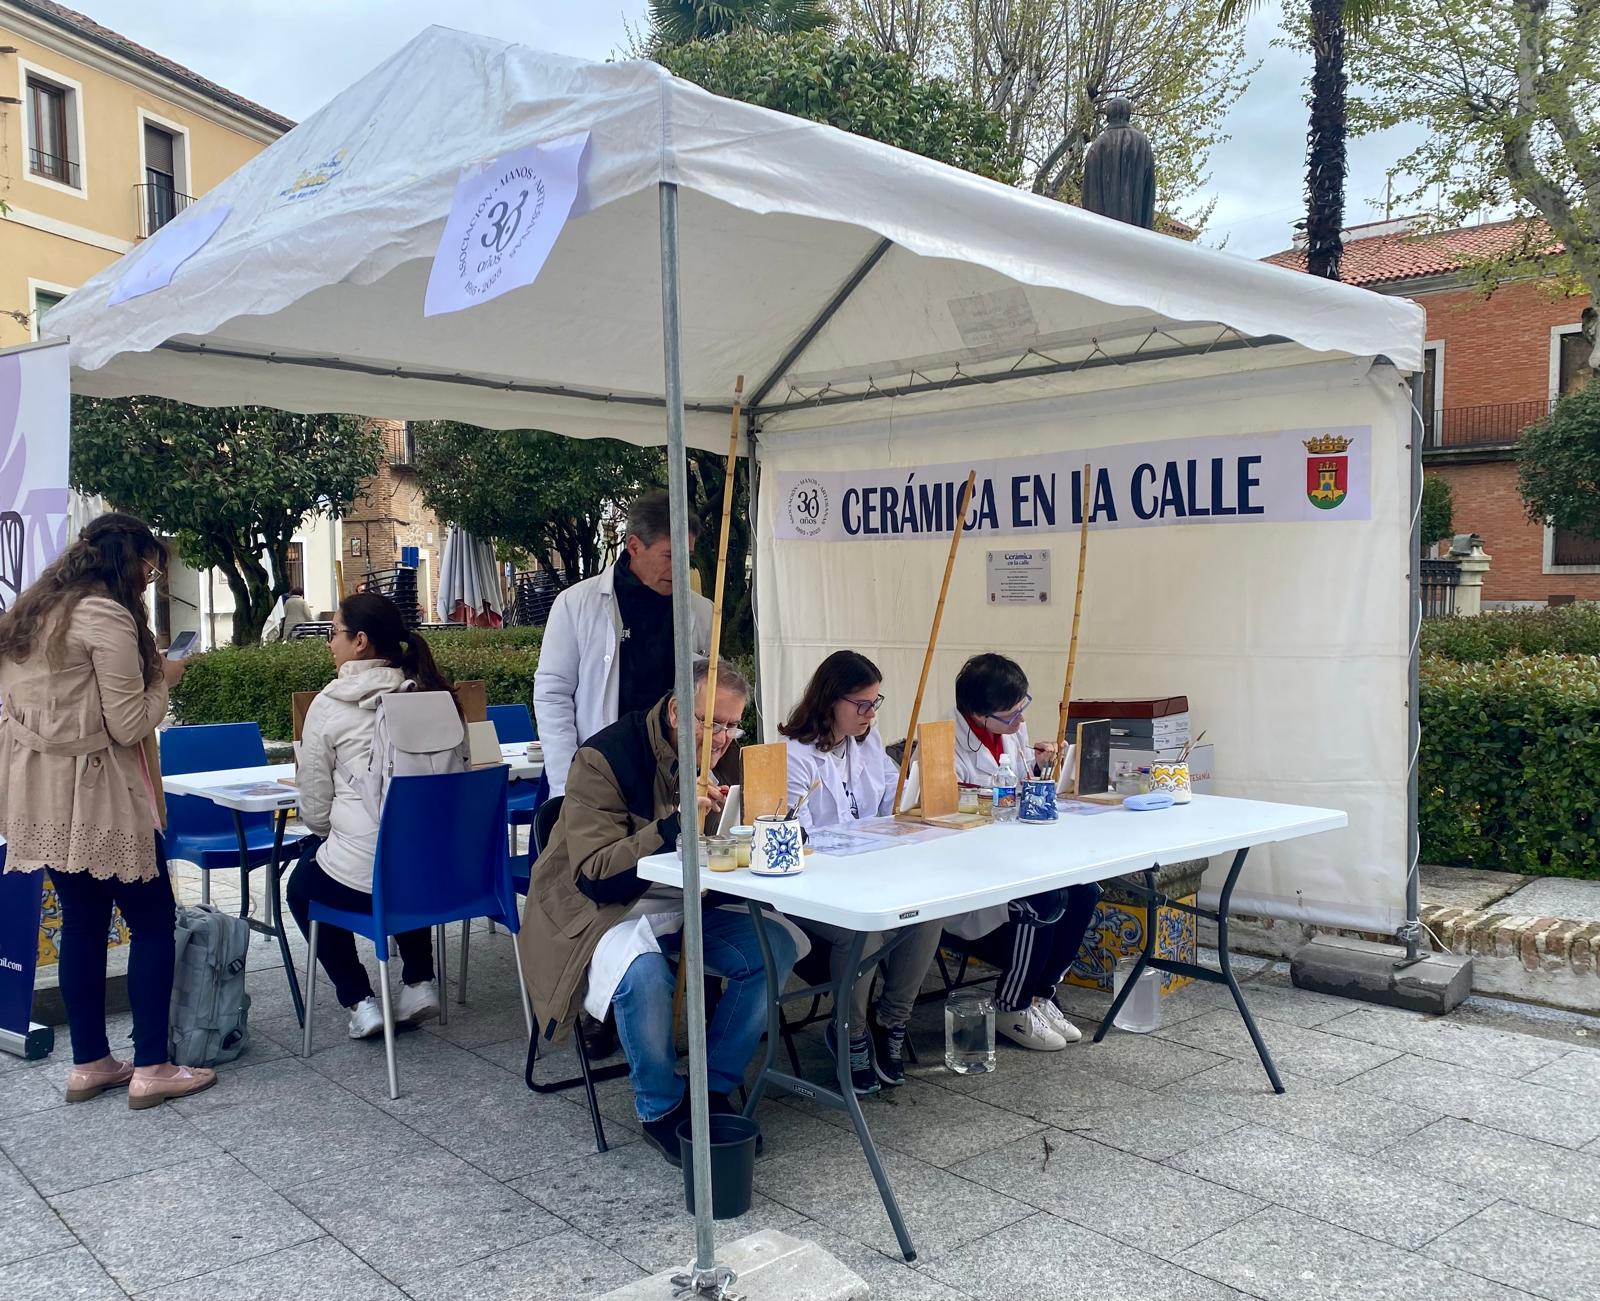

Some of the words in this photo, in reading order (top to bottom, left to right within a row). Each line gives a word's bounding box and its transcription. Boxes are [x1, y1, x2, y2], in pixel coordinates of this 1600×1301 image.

[500, 166, 534, 187] MANOS
[480, 189, 529, 252] 30
[797, 489, 819, 518] 30
[842, 473, 999, 535] CERÁMICA
[1011, 473, 1057, 528] EN
[1071, 468, 1118, 523] LA
[1131, 456, 1264, 520] CALLE
[799, 517, 817, 525] años
